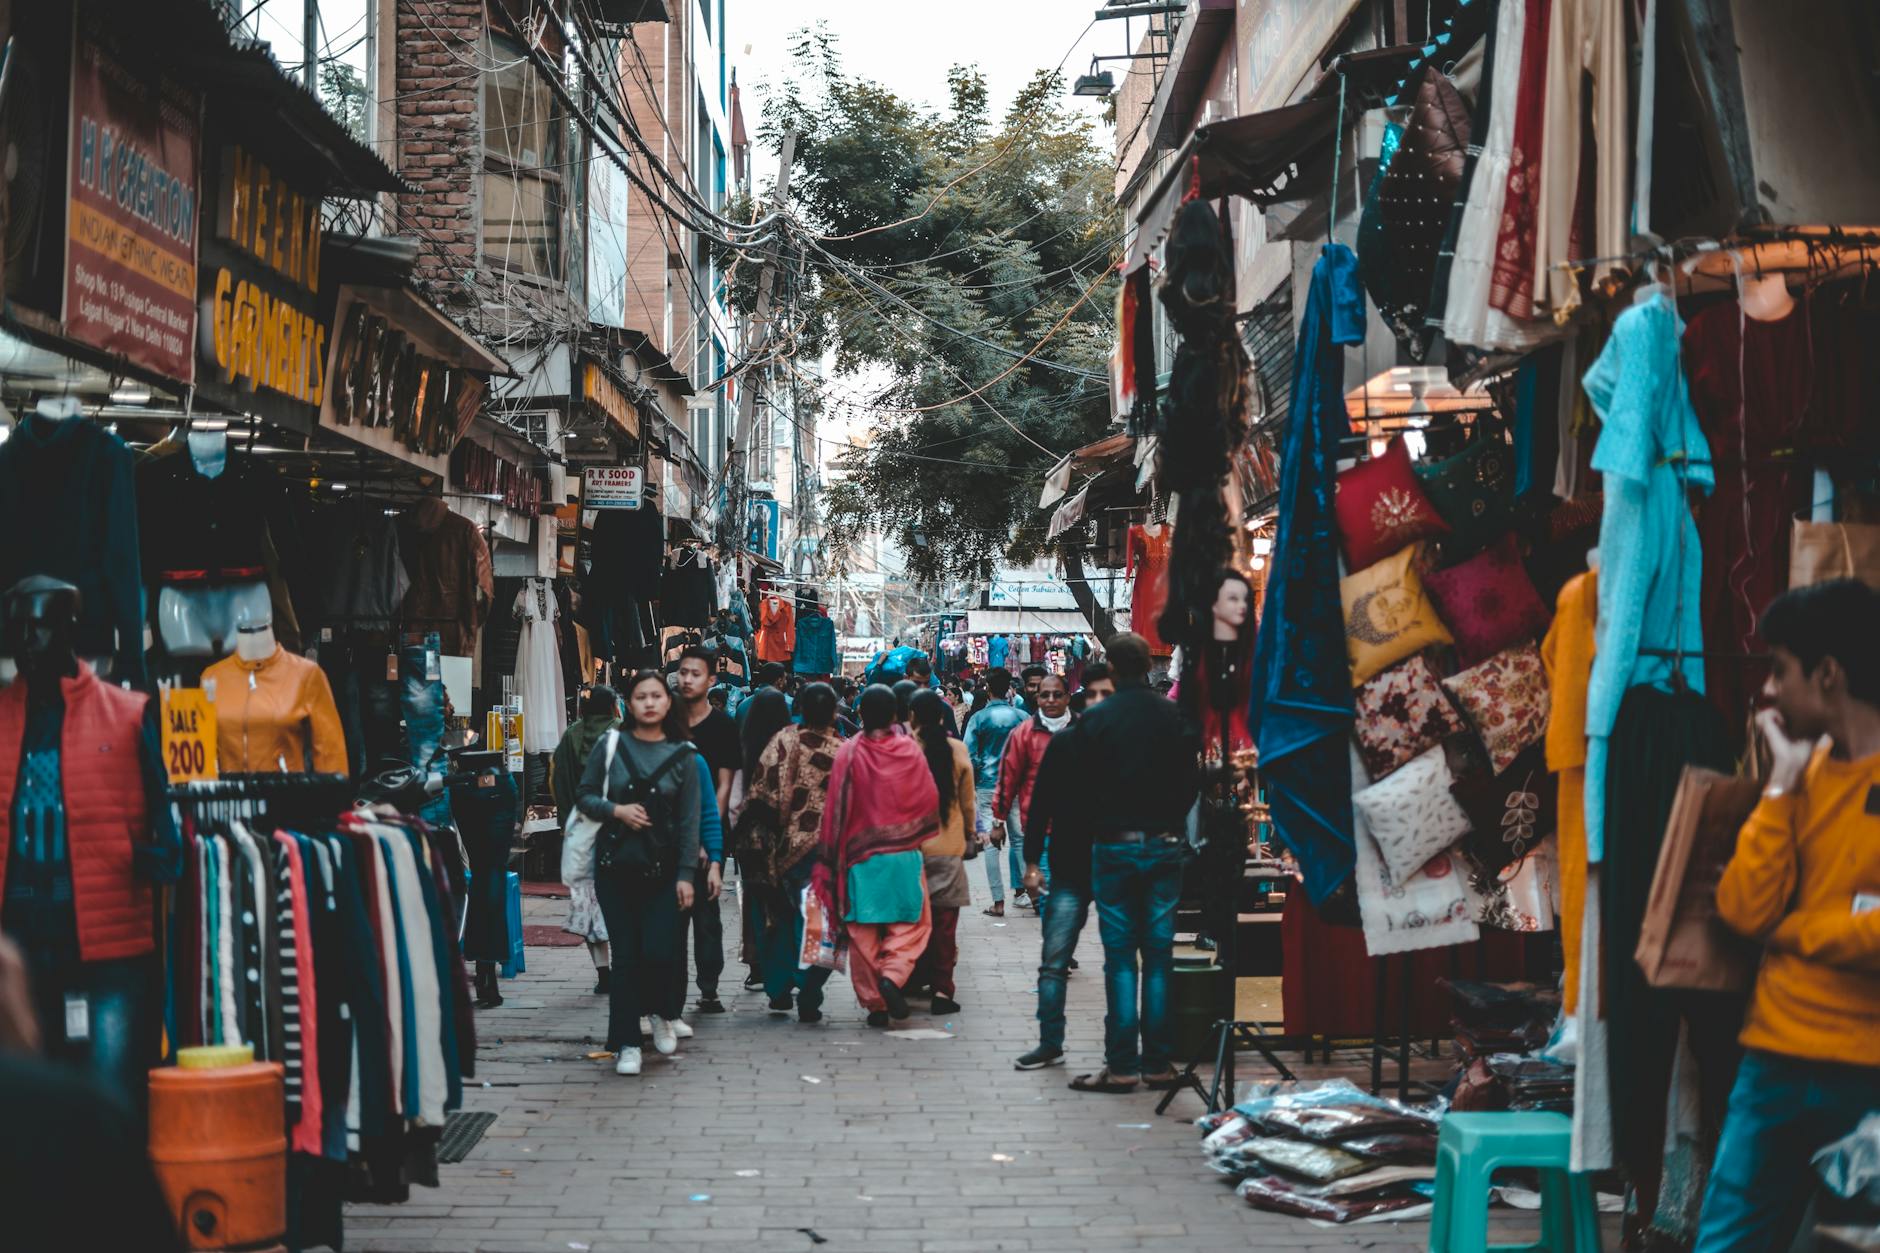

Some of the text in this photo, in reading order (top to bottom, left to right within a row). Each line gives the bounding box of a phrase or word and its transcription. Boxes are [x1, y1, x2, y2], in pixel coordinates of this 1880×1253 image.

[79, 115, 194, 248] H R CREATION
[80, 211, 189, 287] INDIAN ETHNIC WEAR
[231, 144, 321, 294] MEENU
[75, 263, 96, 294] Shop
[96, 275, 108, 297] No.
[110, 281, 119, 300] 13
[144, 297, 168, 325] Central
[168, 307, 189, 335] Market
[79, 295, 103, 323] Lajpat
[103, 304, 125, 334] Nagar
[125, 314, 131, 333] 2
[131, 318, 145, 339] New
[145, 324, 162, 347] Delhi
[213, 266, 325, 407] GARMENTS
[588, 470, 635, 479] R K SOOD
[1031, 584, 1056, 593] Fabrics
[170, 709, 197, 733] SALE
[169, 740, 205, 775] 200
